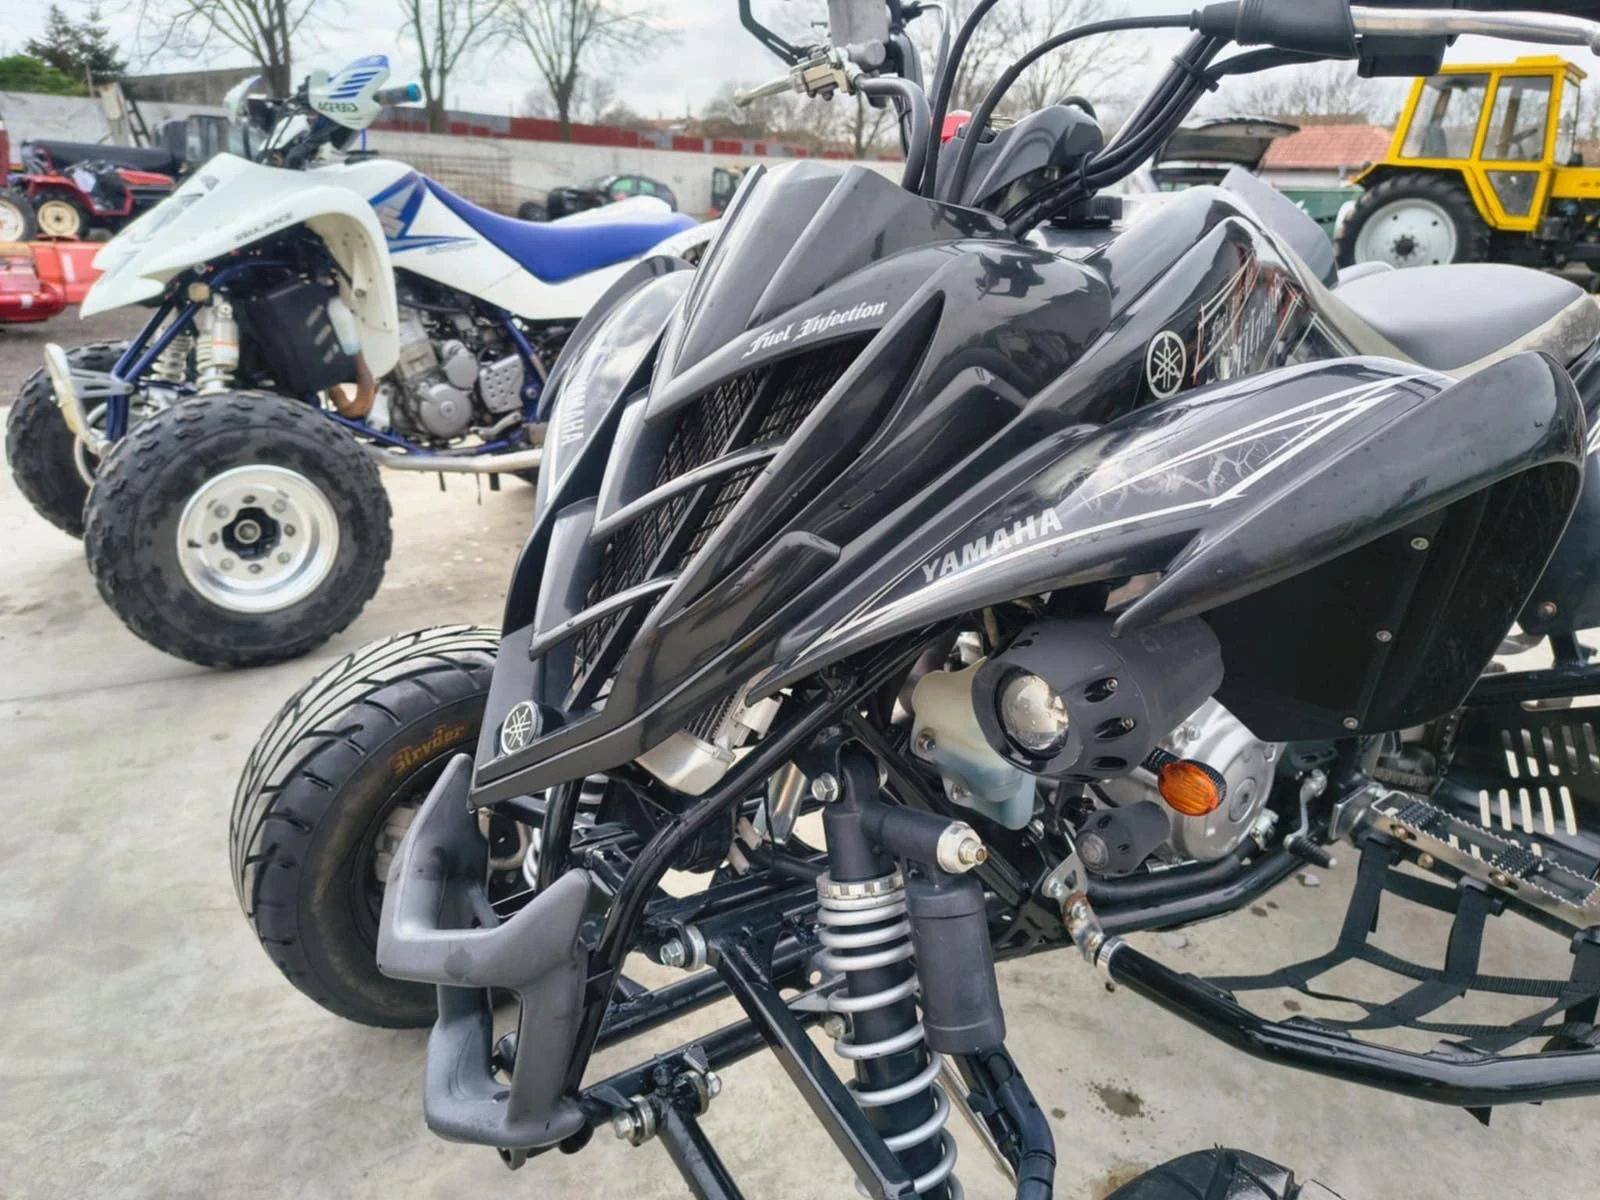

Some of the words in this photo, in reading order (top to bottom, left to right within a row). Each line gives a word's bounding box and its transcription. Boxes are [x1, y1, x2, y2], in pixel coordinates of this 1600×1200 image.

[740, 322, 796, 360] Fuel
[792, 301, 888, 343] Injection
[921, 506, 1063, 584] YAMAHA
